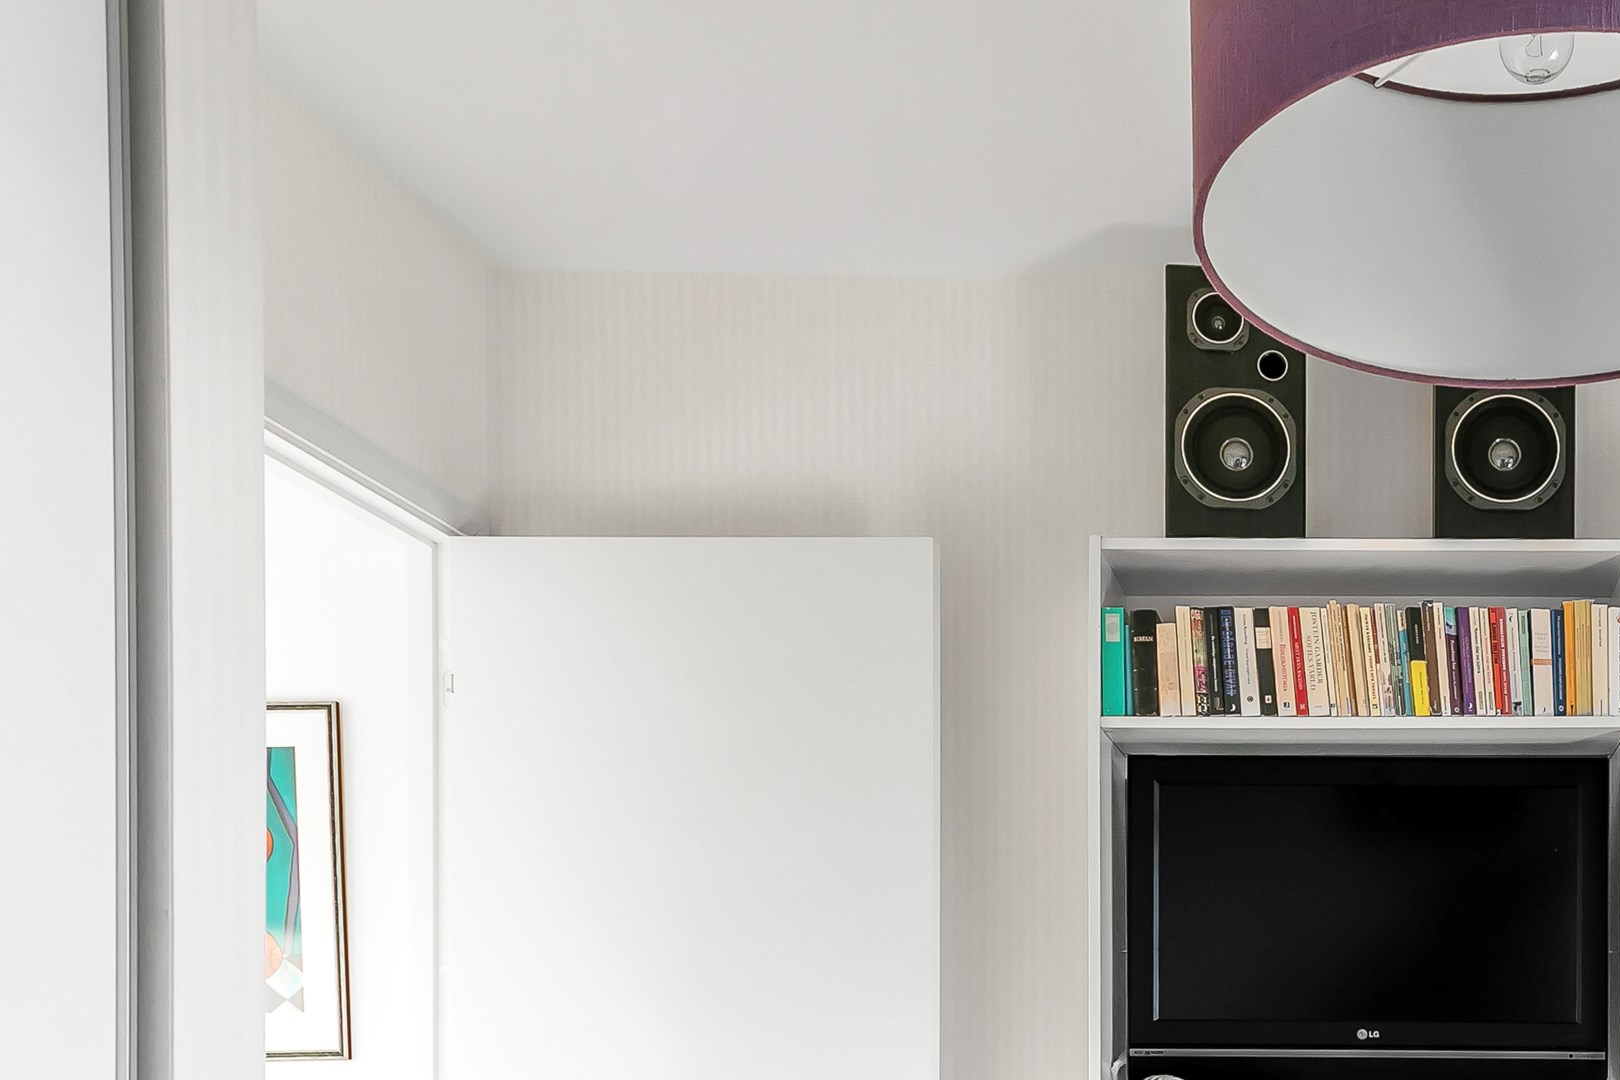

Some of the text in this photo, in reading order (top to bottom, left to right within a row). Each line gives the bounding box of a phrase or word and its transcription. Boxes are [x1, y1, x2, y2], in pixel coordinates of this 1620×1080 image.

[1133, 635, 1154, 643] BIBELN
[1310, 612, 1323, 685] JOSTEIN GAARDER
[1306, 635, 1318, 691] SOFIES VÄRLD
[1368, 1030, 1380, 1038] LG
